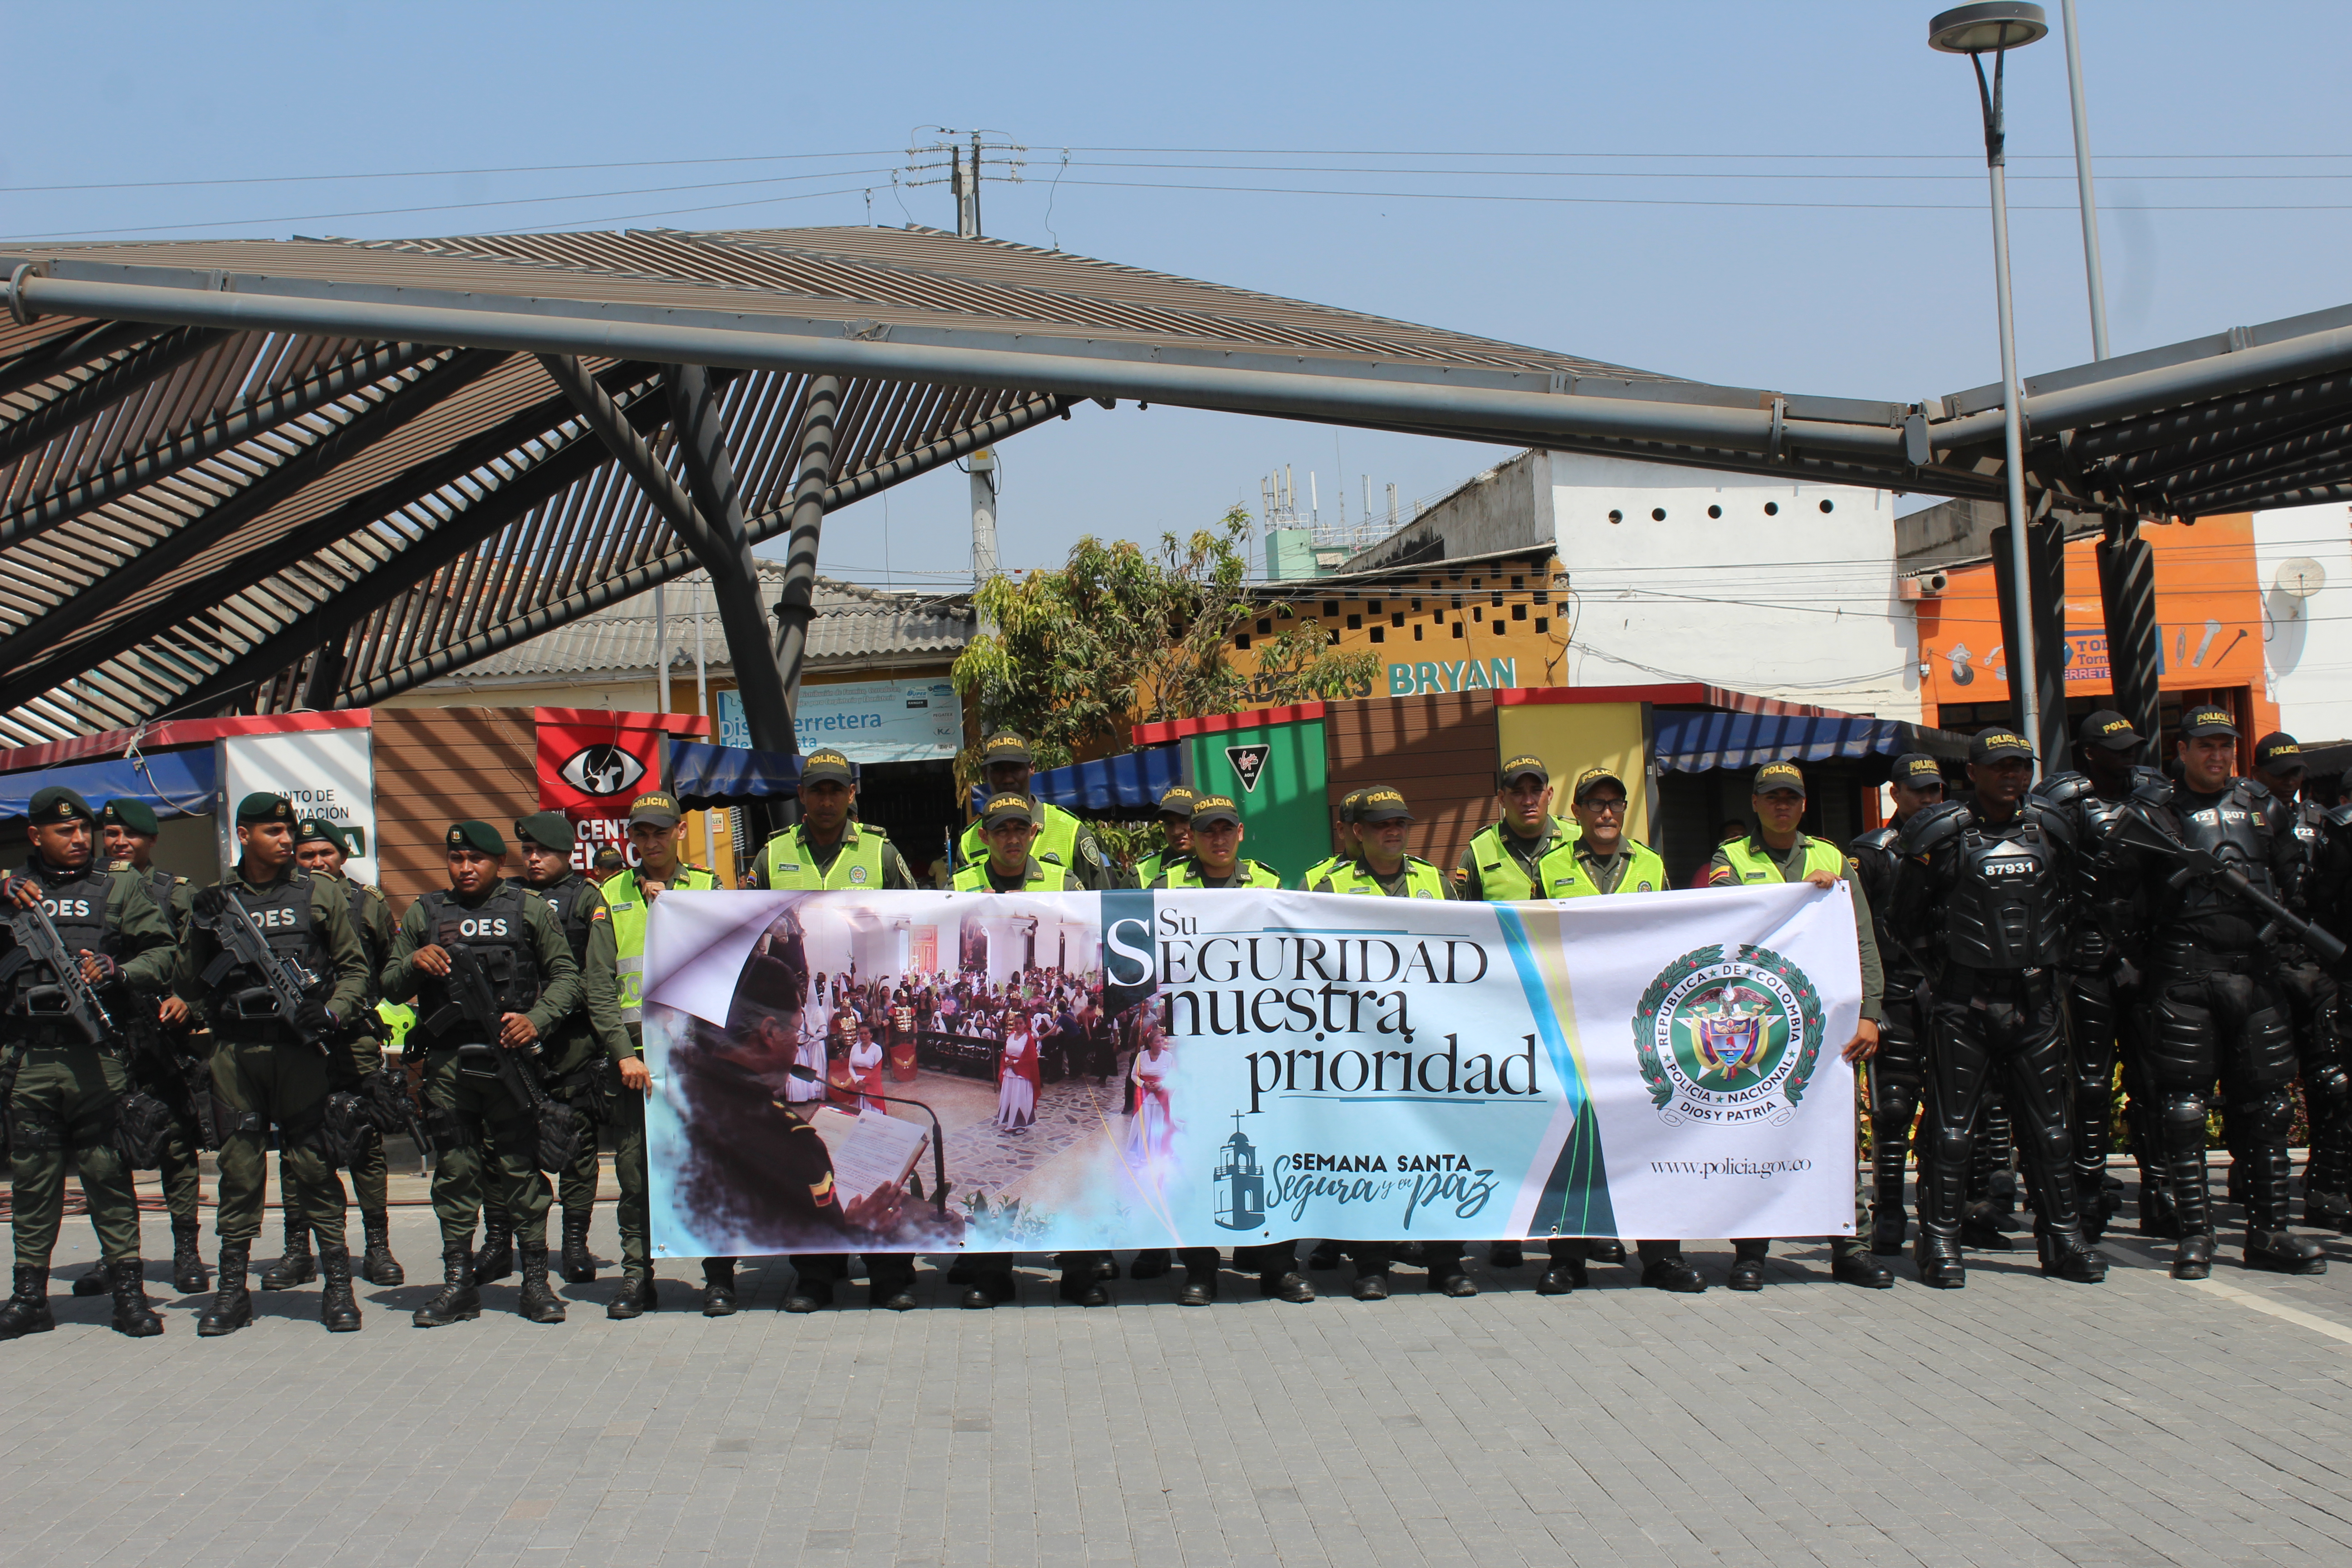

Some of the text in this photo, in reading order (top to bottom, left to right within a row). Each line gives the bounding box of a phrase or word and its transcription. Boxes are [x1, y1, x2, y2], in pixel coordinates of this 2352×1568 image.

[1388, 657, 1516, 697] BRYAN
[2064, 667, 2111, 679] ERRETE
[794, 710, 882, 733] erretera
[2197, 712, 2230, 722] POLICIA
[986, 736, 1024, 752] POLICIA
[1985, 734, 2019, 746] POLICIA
[2269, 745, 2300, 757] POLICIA
[806, 754, 847, 768] POLICIA
[1238, 750, 1258, 771] Virgin
[1504, 757, 1542, 772] POLICIA
[1909, 760, 1939, 771] POLICIA
[1762, 765, 1801, 779] POLICIA
[317, 789, 334, 801] DE
[1161, 788, 1193, 802] POLICIA
[1366, 790, 1405, 805] POLICIA
[295, 804, 349, 819] MACIÓN
[632, 797, 670, 811] POLICIA
[989, 797, 1029, 812] POLICIA
[1193, 798, 1234, 814] POLICIA
[577, 819, 630, 840] CENT
[1985, 862, 2034, 876] 87931
[42, 899, 90, 917] OES
[459, 918, 508, 937] OES
[1159, 907, 1197, 937] Su
[1107, 918, 1488, 987] SEGURIDAD
[1161, 981, 1416, 1038] nuestra
[1658, 965, 1800, 1047] REPÚBLICA DE COLOMBIA
[1245, 1032, 1542, 1114] prioridad
[1728, 1058, 1794, 1103] NACIONAL
[1726, 1101, 1777, 1121] PATRIA
[1292, 1153, 1472, 1172] SEMANA SANTA
[1651, 1157, 1812, 1179] www.policia.gov.co
[1266, 1155, 1500, 1230] Segura y en paz
